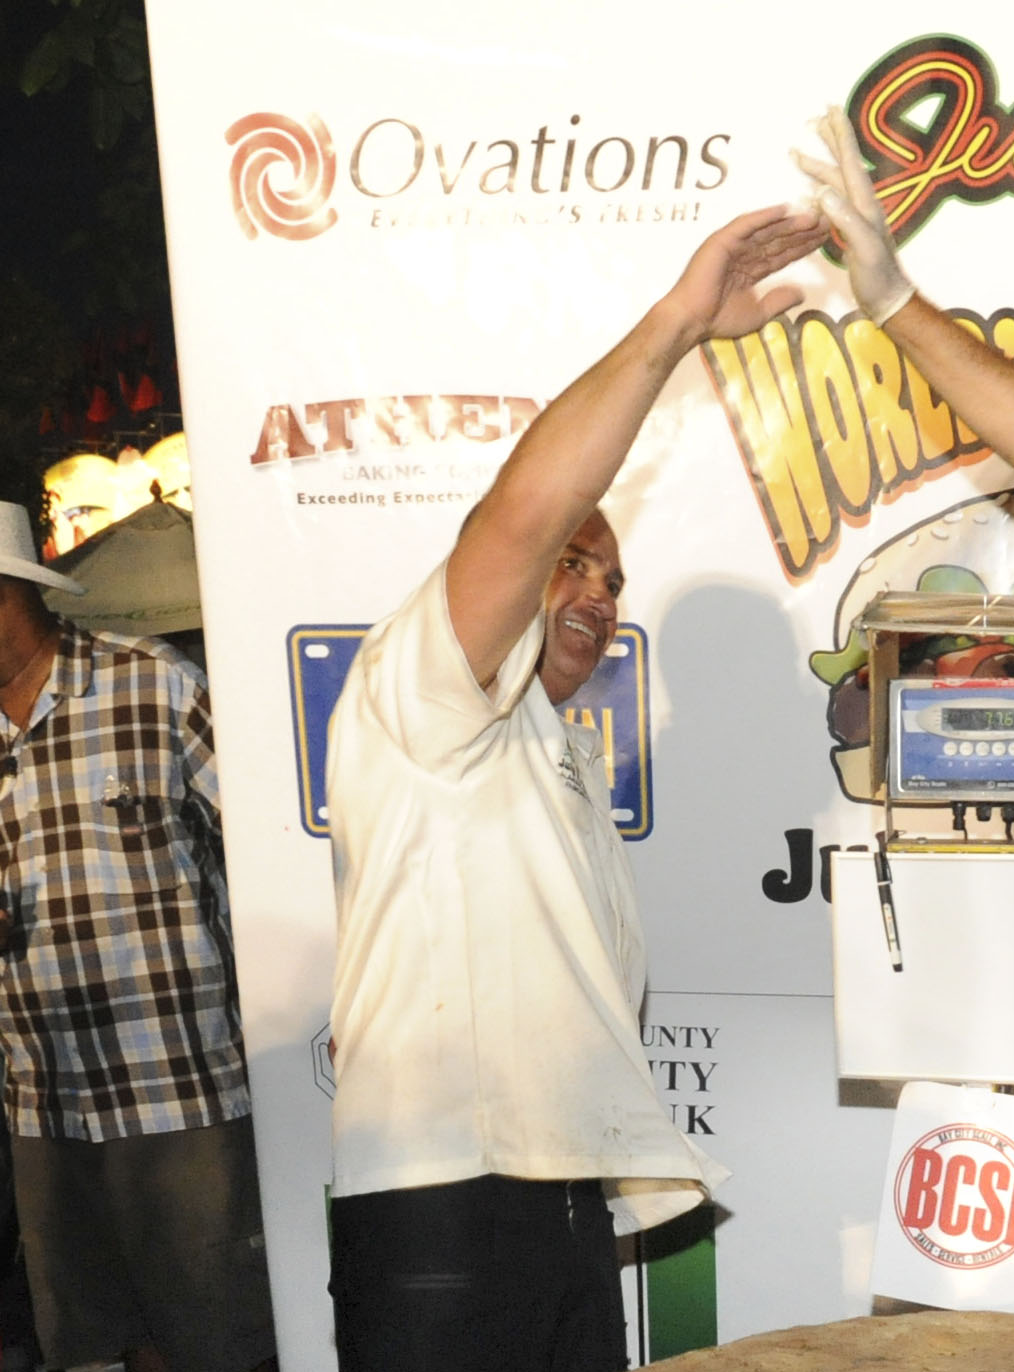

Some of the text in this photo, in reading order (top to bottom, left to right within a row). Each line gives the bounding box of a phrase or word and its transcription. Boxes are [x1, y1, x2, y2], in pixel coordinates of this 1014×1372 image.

[348, 113, 732, 199] Ovations
[297, 491, 387, 508] Exceeding
[640, 1024, 720, 1049] UNTY
